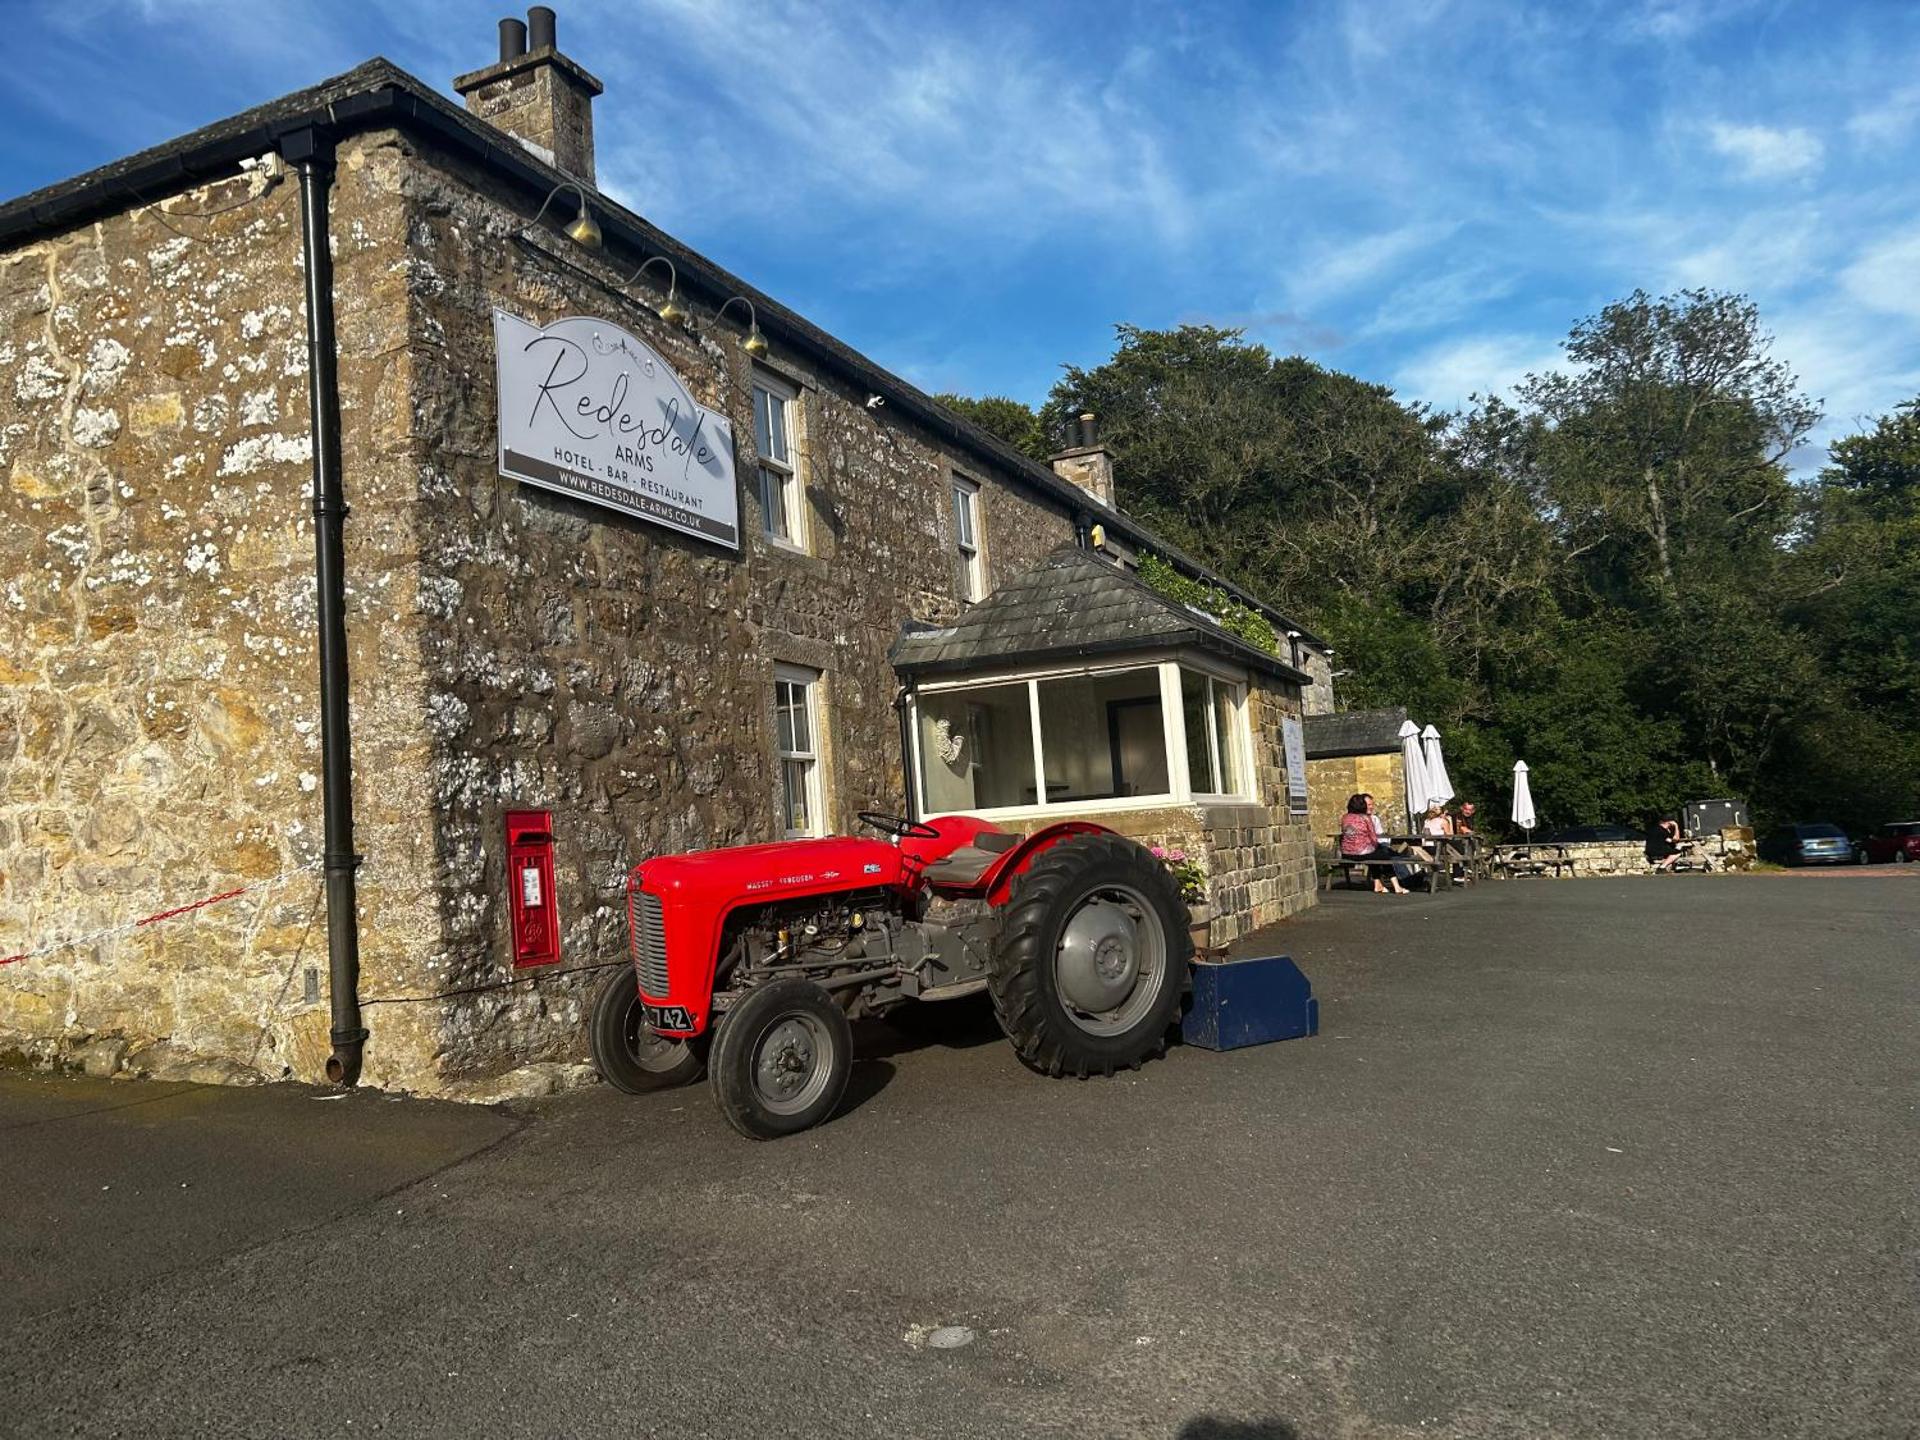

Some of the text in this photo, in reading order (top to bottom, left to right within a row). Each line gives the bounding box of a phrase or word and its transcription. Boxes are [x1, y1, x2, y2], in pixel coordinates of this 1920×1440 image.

[524, 336, 717, 480] Redesdale
[554, 446, 594, 471] HOTEL
[607, 465, 629, 482] BAR
[640, 478, 703, 510] RESTAURANT
[615, 444, 654, 472] ARMS
[558, 470, 702, 528] WWW.REDESDALE-ARMS.CO.UK
[746, 881, 773, 890] MASSEY
